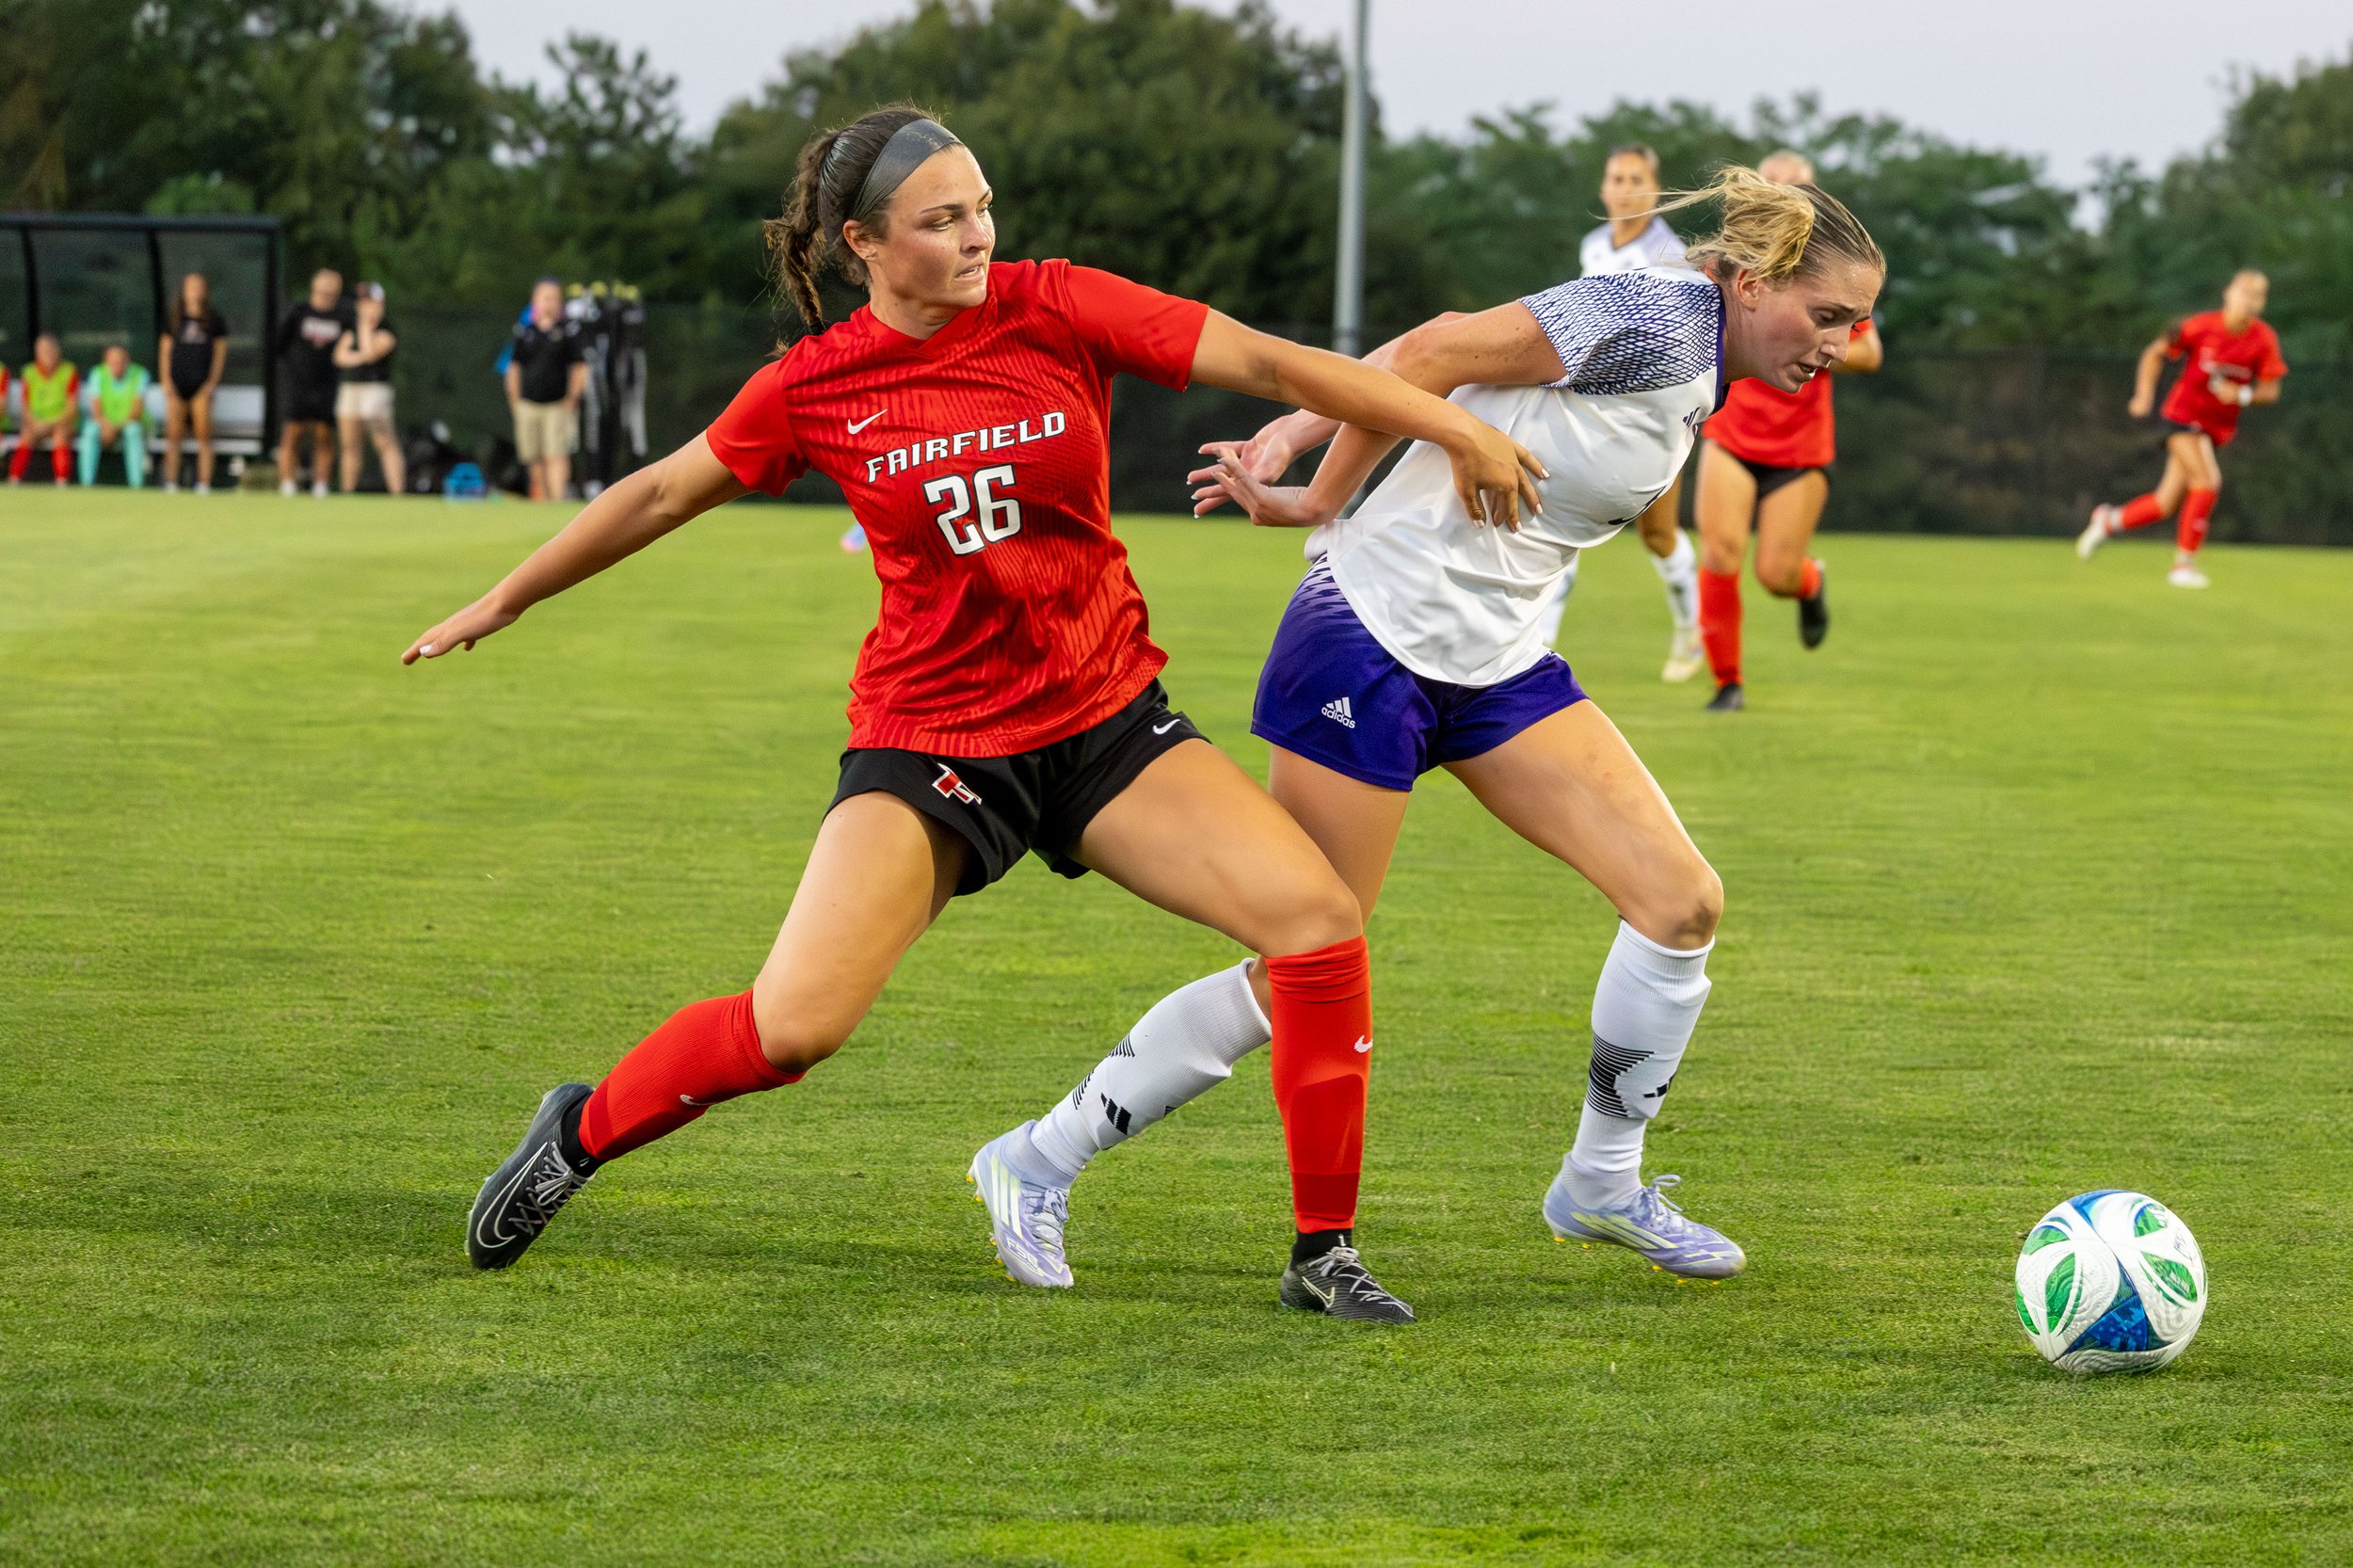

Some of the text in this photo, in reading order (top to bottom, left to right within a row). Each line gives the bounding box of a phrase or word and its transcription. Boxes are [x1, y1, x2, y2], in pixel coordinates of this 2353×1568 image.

[866, 411, 1065, 483] FAIRFIELD
[922, 463, 1021, 555] 26
[1321, 707, 1355, 728] adidas
